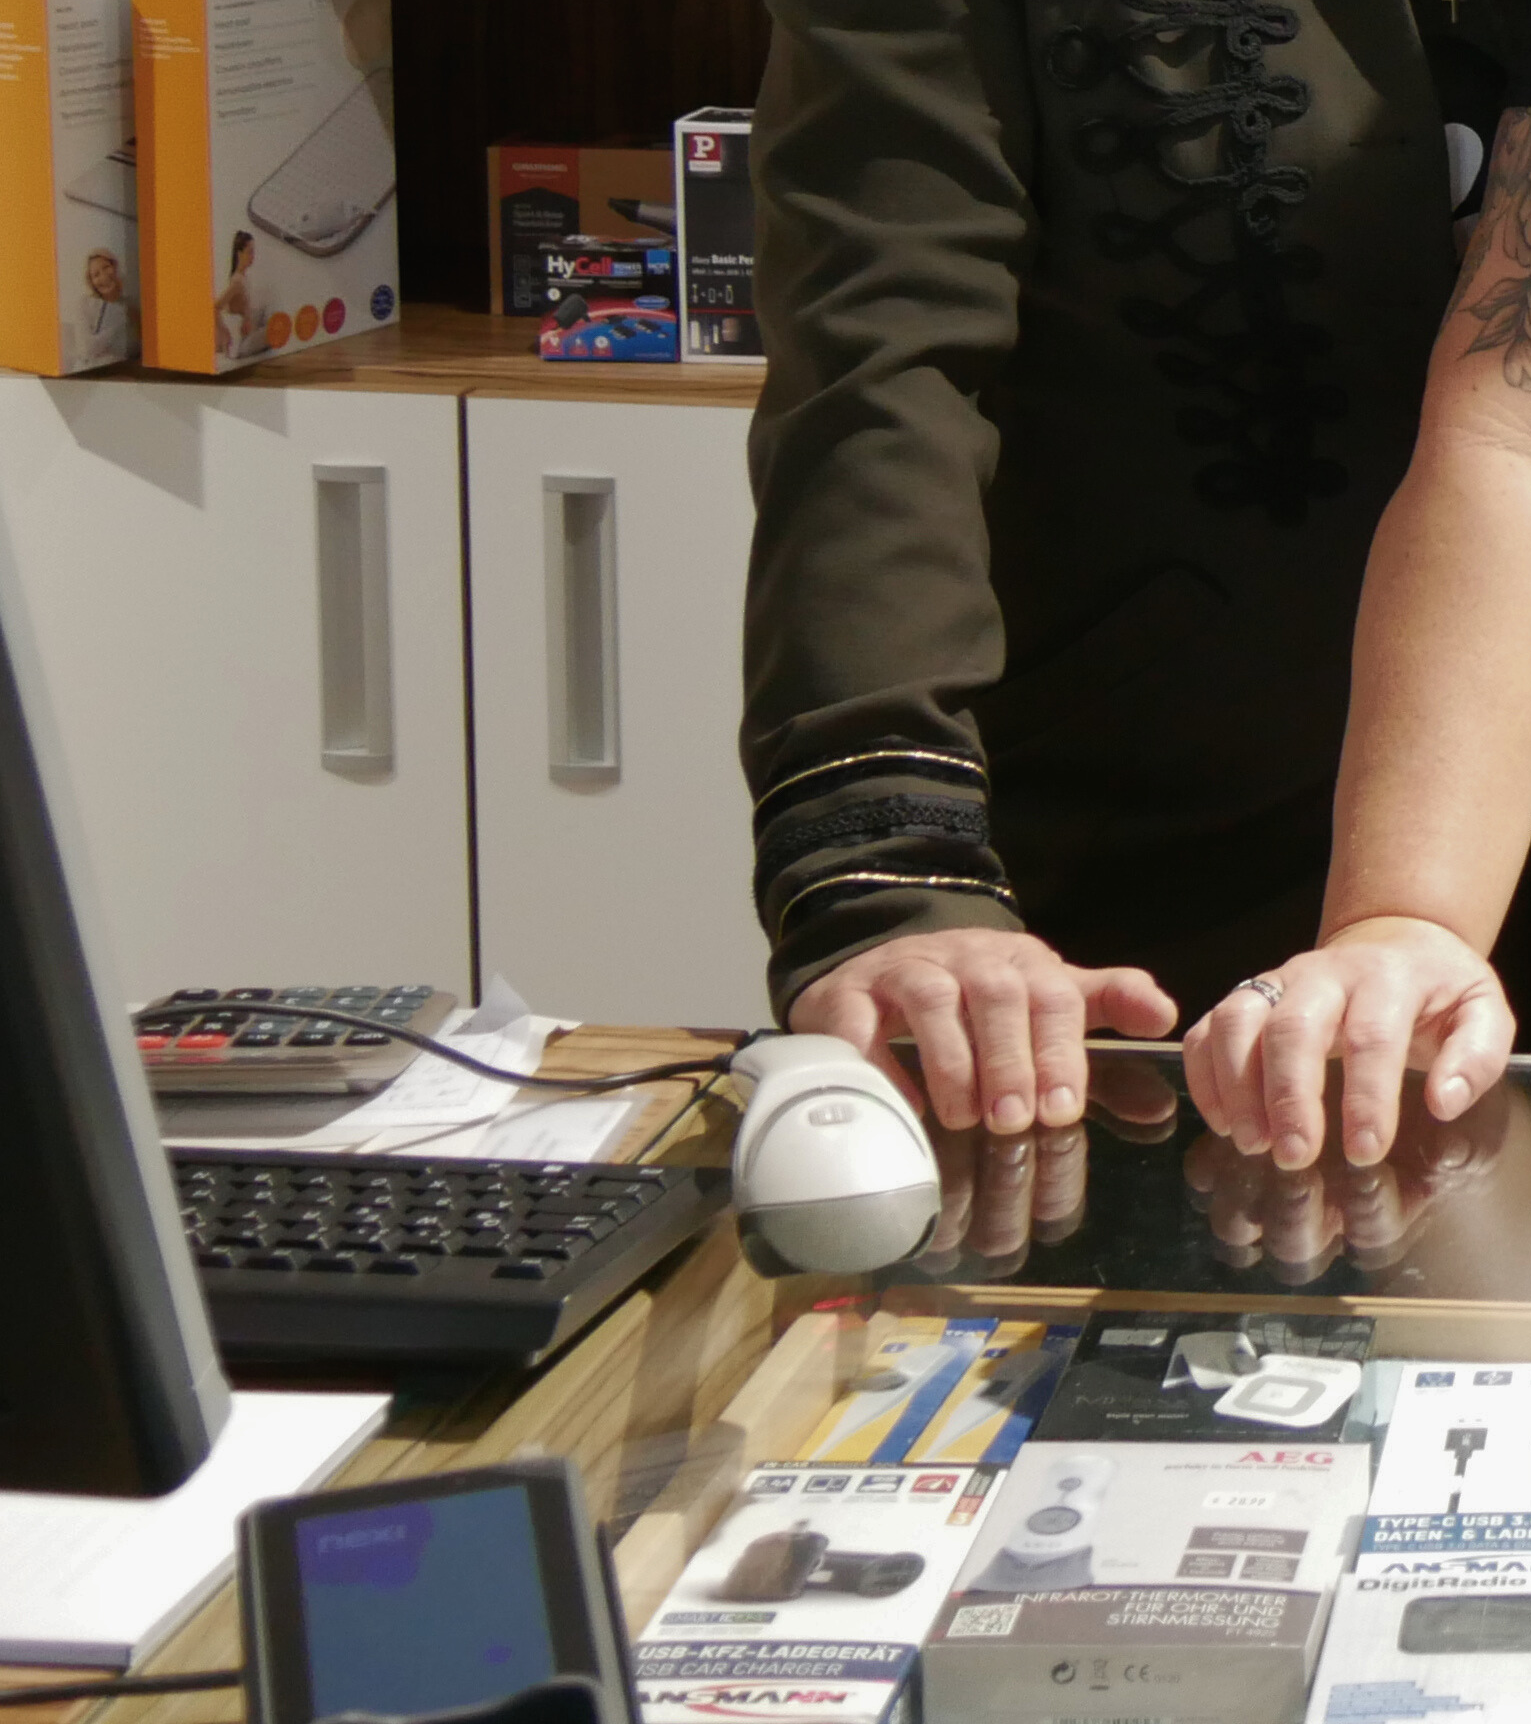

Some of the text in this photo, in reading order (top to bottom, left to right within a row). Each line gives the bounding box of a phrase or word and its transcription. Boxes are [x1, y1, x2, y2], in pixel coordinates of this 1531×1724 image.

[547, 256, 613, 278] HyCell
[711, 255, 736, 265] Basic
[1239, 1451, 1335, 1465] AEG
[1378, 1515, 1456, 1528] TYPE-C
[1462, 1515, 1503, 1527] USB
[1374, 1529, 1453, 1542] DATEN-
[1357, 1574, 1526, 1592] DigitRadio
[1013, 1591, 1287, 1606] INFRAROT-THERMOMETER
[1125, 1602, 1284, 1618] FÜR OHR- UND
[1107, 1613, 1280, 1629] STIRNMESSUNG
[638, 1645, 903, 1662] USB-KFZ-LADEGERÄT
[680, 1662, 844, 1676] CAR CHARGER
